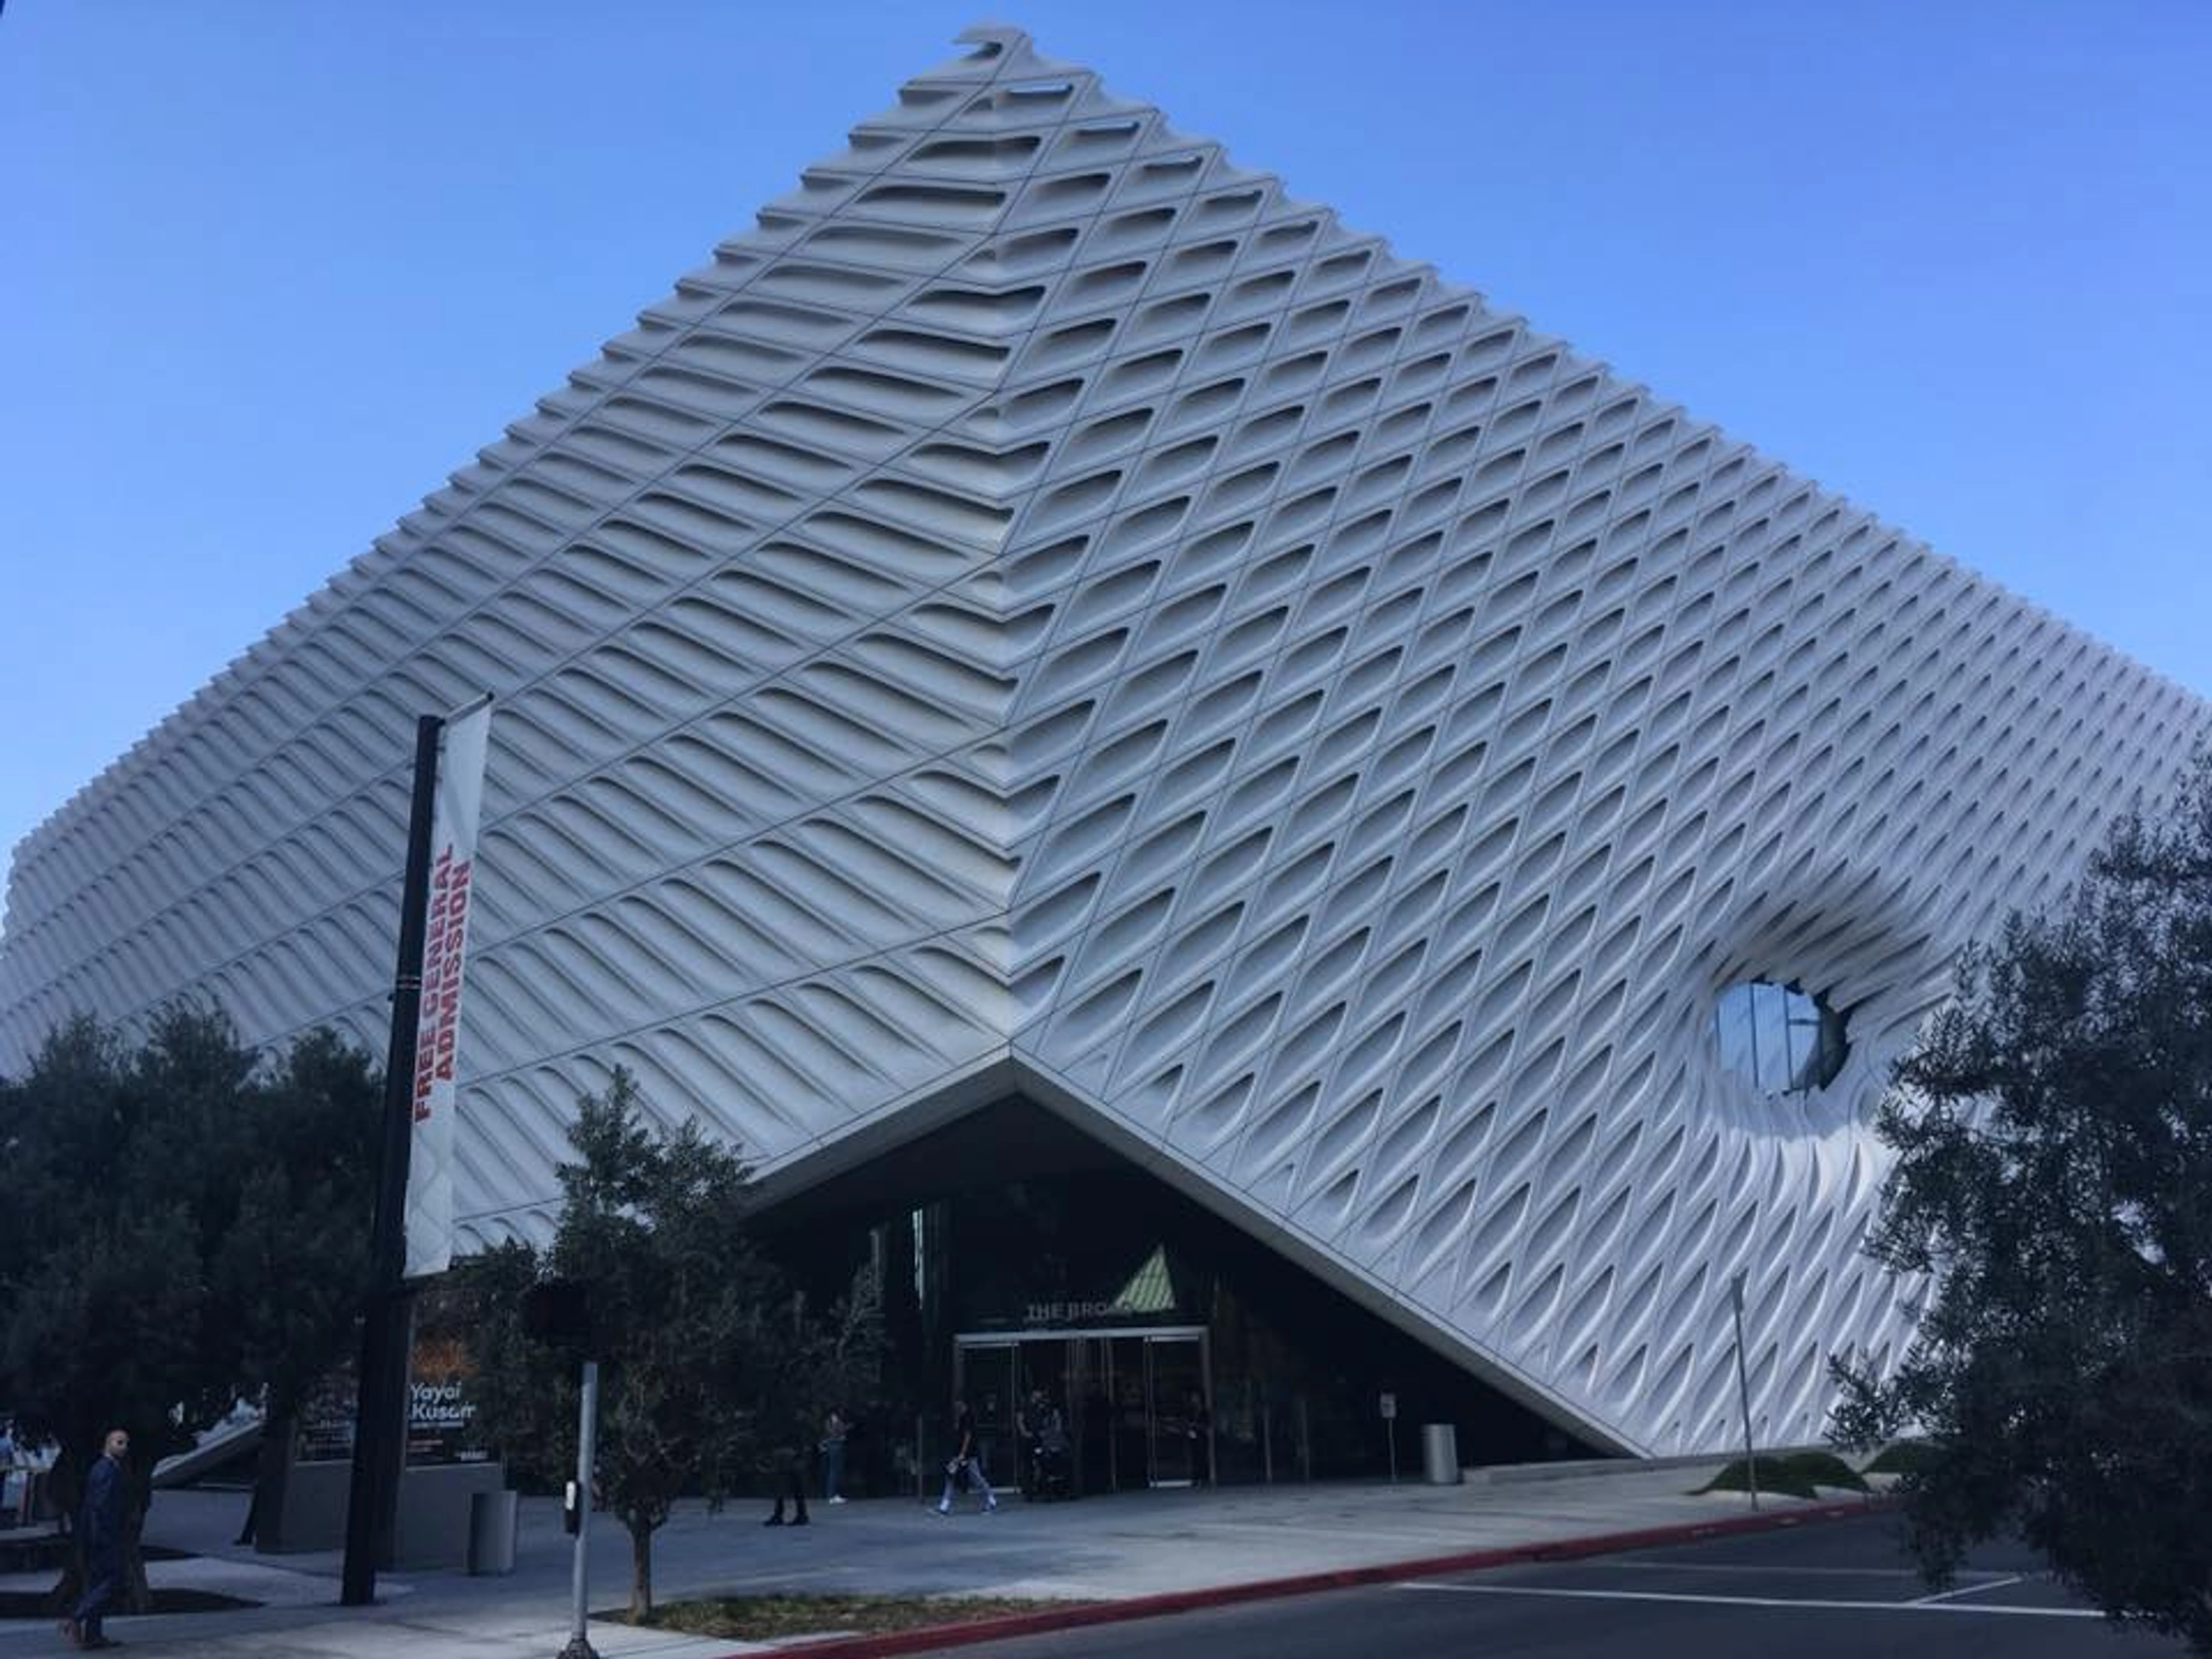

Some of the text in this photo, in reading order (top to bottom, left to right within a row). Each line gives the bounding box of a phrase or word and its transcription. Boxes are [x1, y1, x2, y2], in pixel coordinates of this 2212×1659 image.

[415, 844, 453, 1123] FREE GENERAL
[436, 860, 471, 1081] ADMISSION
[1025, 1301, 1065, 1320] THE
